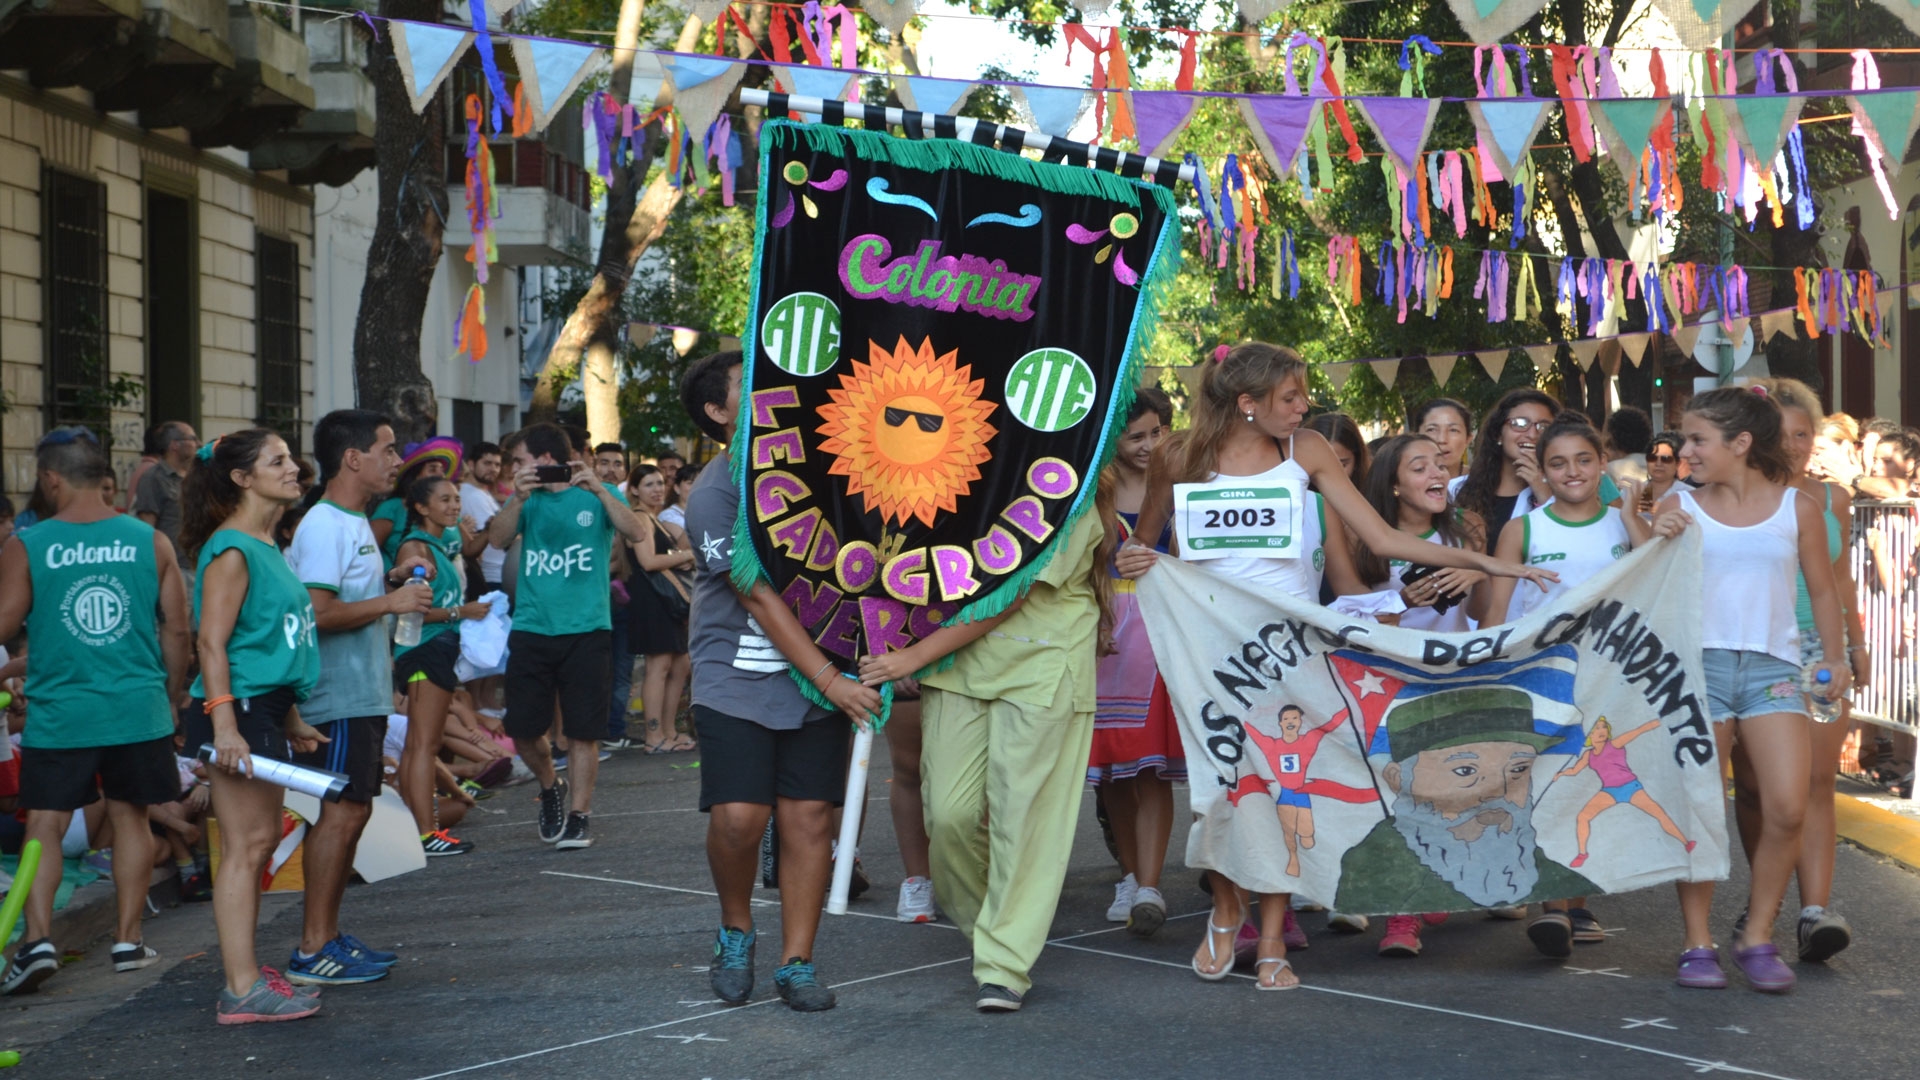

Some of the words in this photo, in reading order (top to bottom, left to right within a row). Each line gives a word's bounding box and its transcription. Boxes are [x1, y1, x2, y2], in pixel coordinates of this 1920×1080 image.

[838, 233, 1042, 322] Colonia
[762, 291, 841, 377] ATE
[1004, 347, 1097, 432] ATE
[750, 385, 879, 593] LEGADO
[881, 456, 1078, 606] GRUPO
[1220, 490, 1256, 498] GINA
[1204, 508, 1276, 528] 2003
[46, 539, 137, 569] Colonia
[525, 544, 593, 578] PROFE
[78, 590, 120, 632] ATE
[1283, 756, 1295, 771] 5
